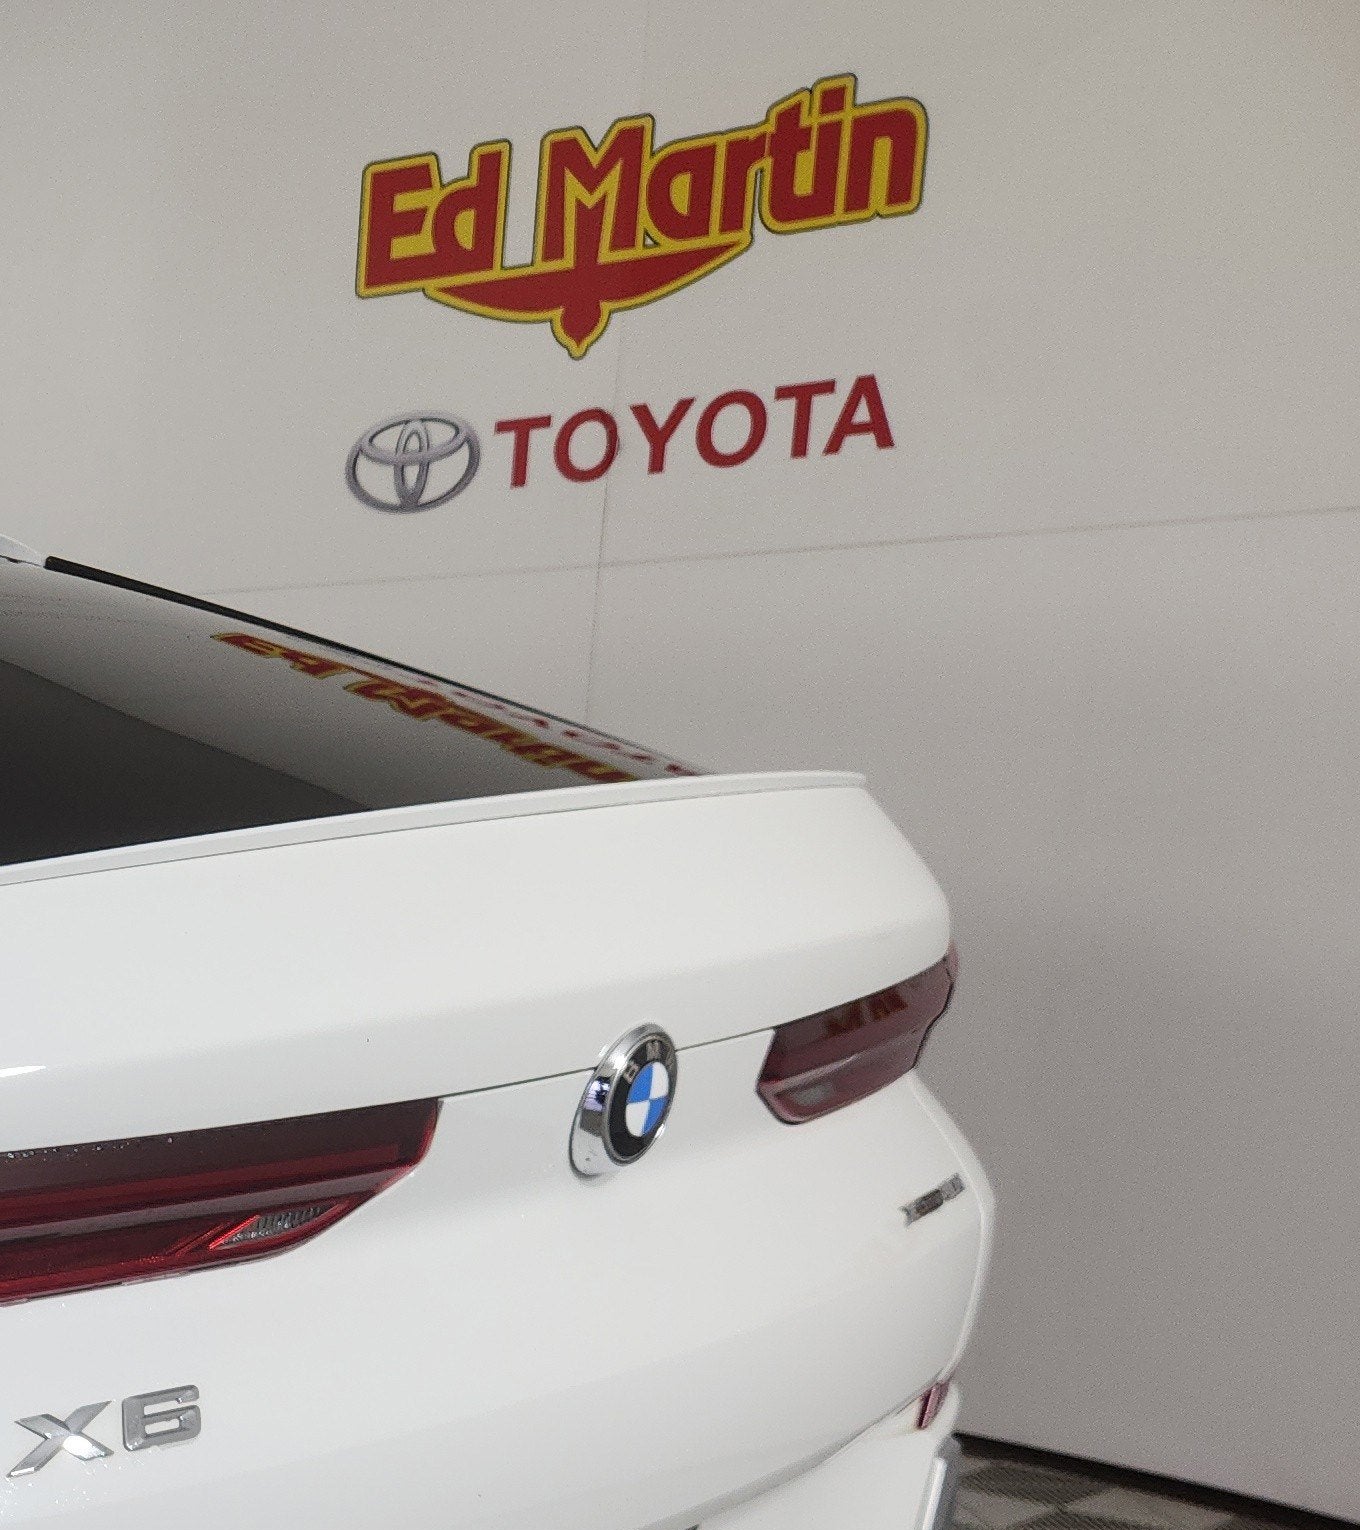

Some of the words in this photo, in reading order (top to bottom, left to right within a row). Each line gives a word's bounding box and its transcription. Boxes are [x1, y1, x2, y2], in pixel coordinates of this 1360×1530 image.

[359, 142, 507, 292] Ed
[537, 79, 922, 266] Martin
[494, 373, 896, 489] TOYOTA
[5, 1384, 202, 1479] X6
